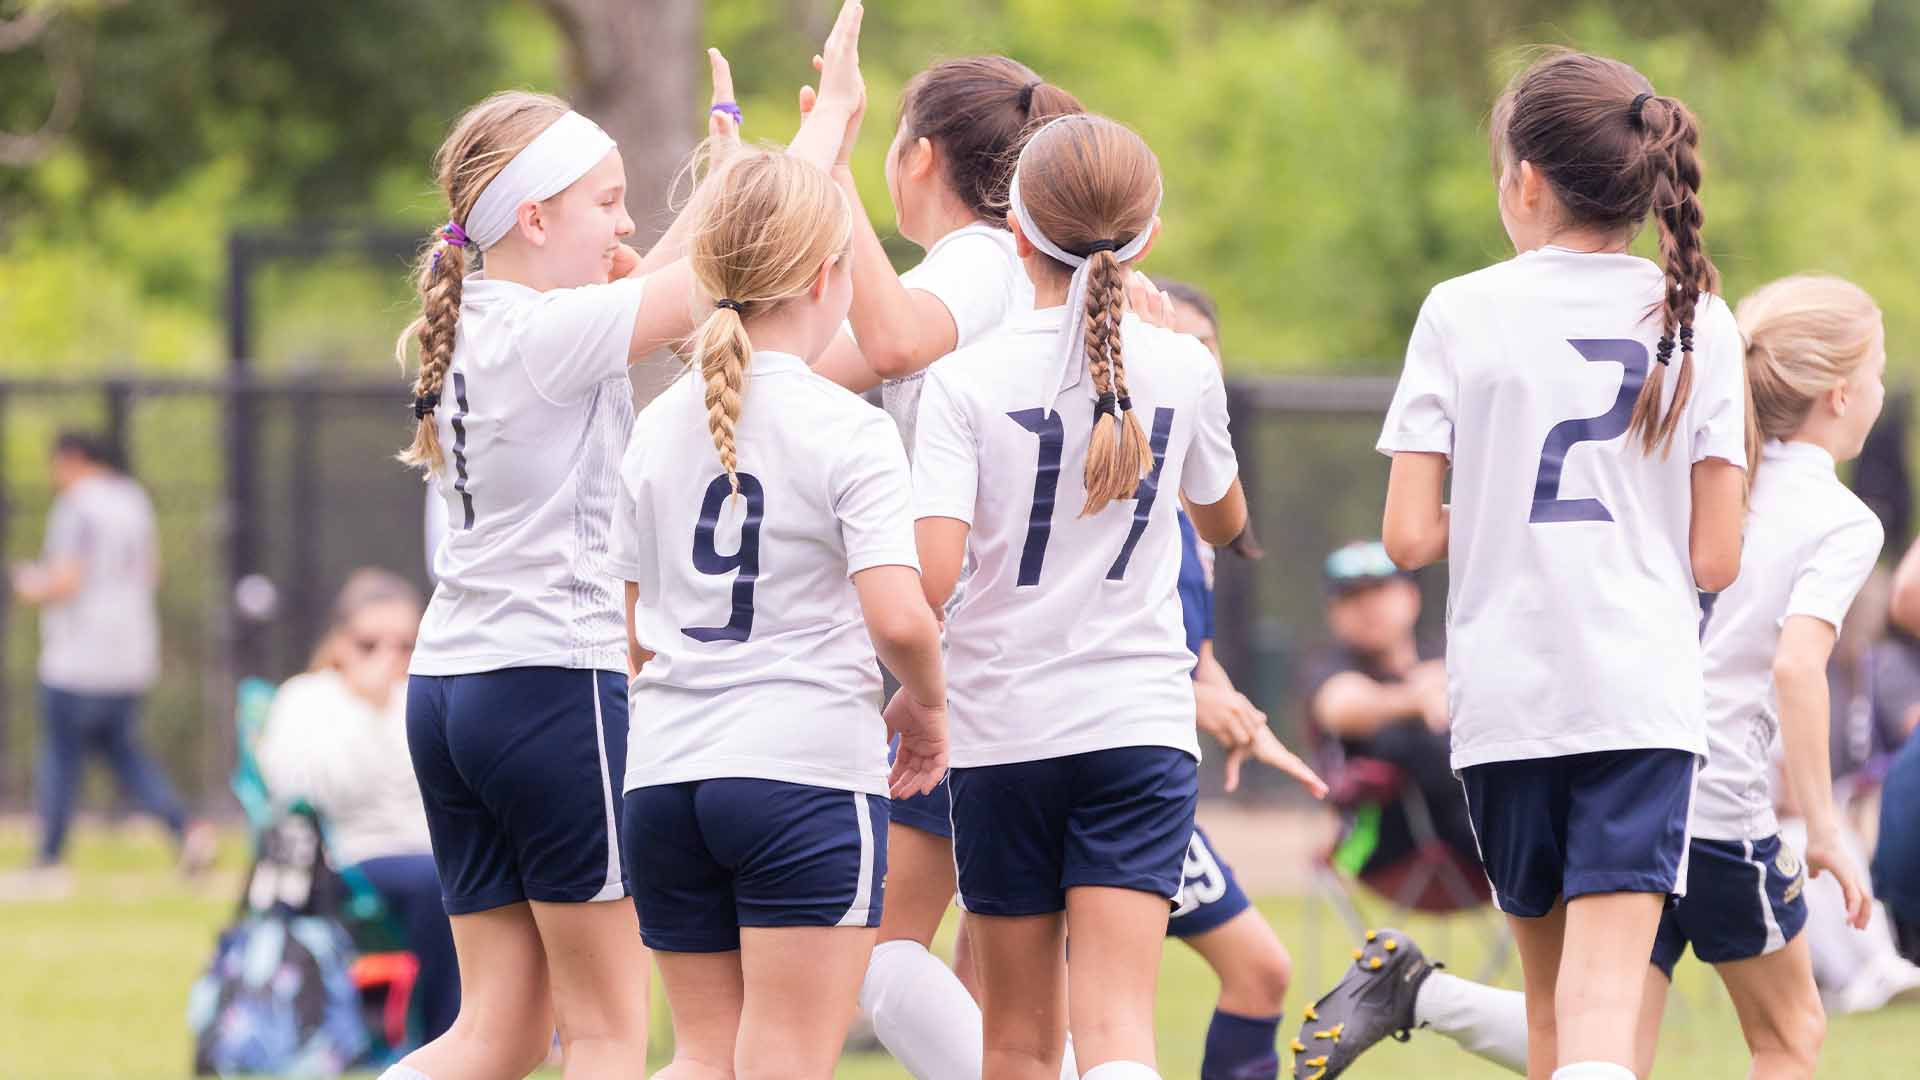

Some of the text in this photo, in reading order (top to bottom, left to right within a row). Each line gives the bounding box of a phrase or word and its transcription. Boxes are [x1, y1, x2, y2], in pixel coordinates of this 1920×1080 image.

[1528, 338, 1650, 524] 2
[680, 472, 765, 642] 9
[1169, 830, 1227, 919] 9
